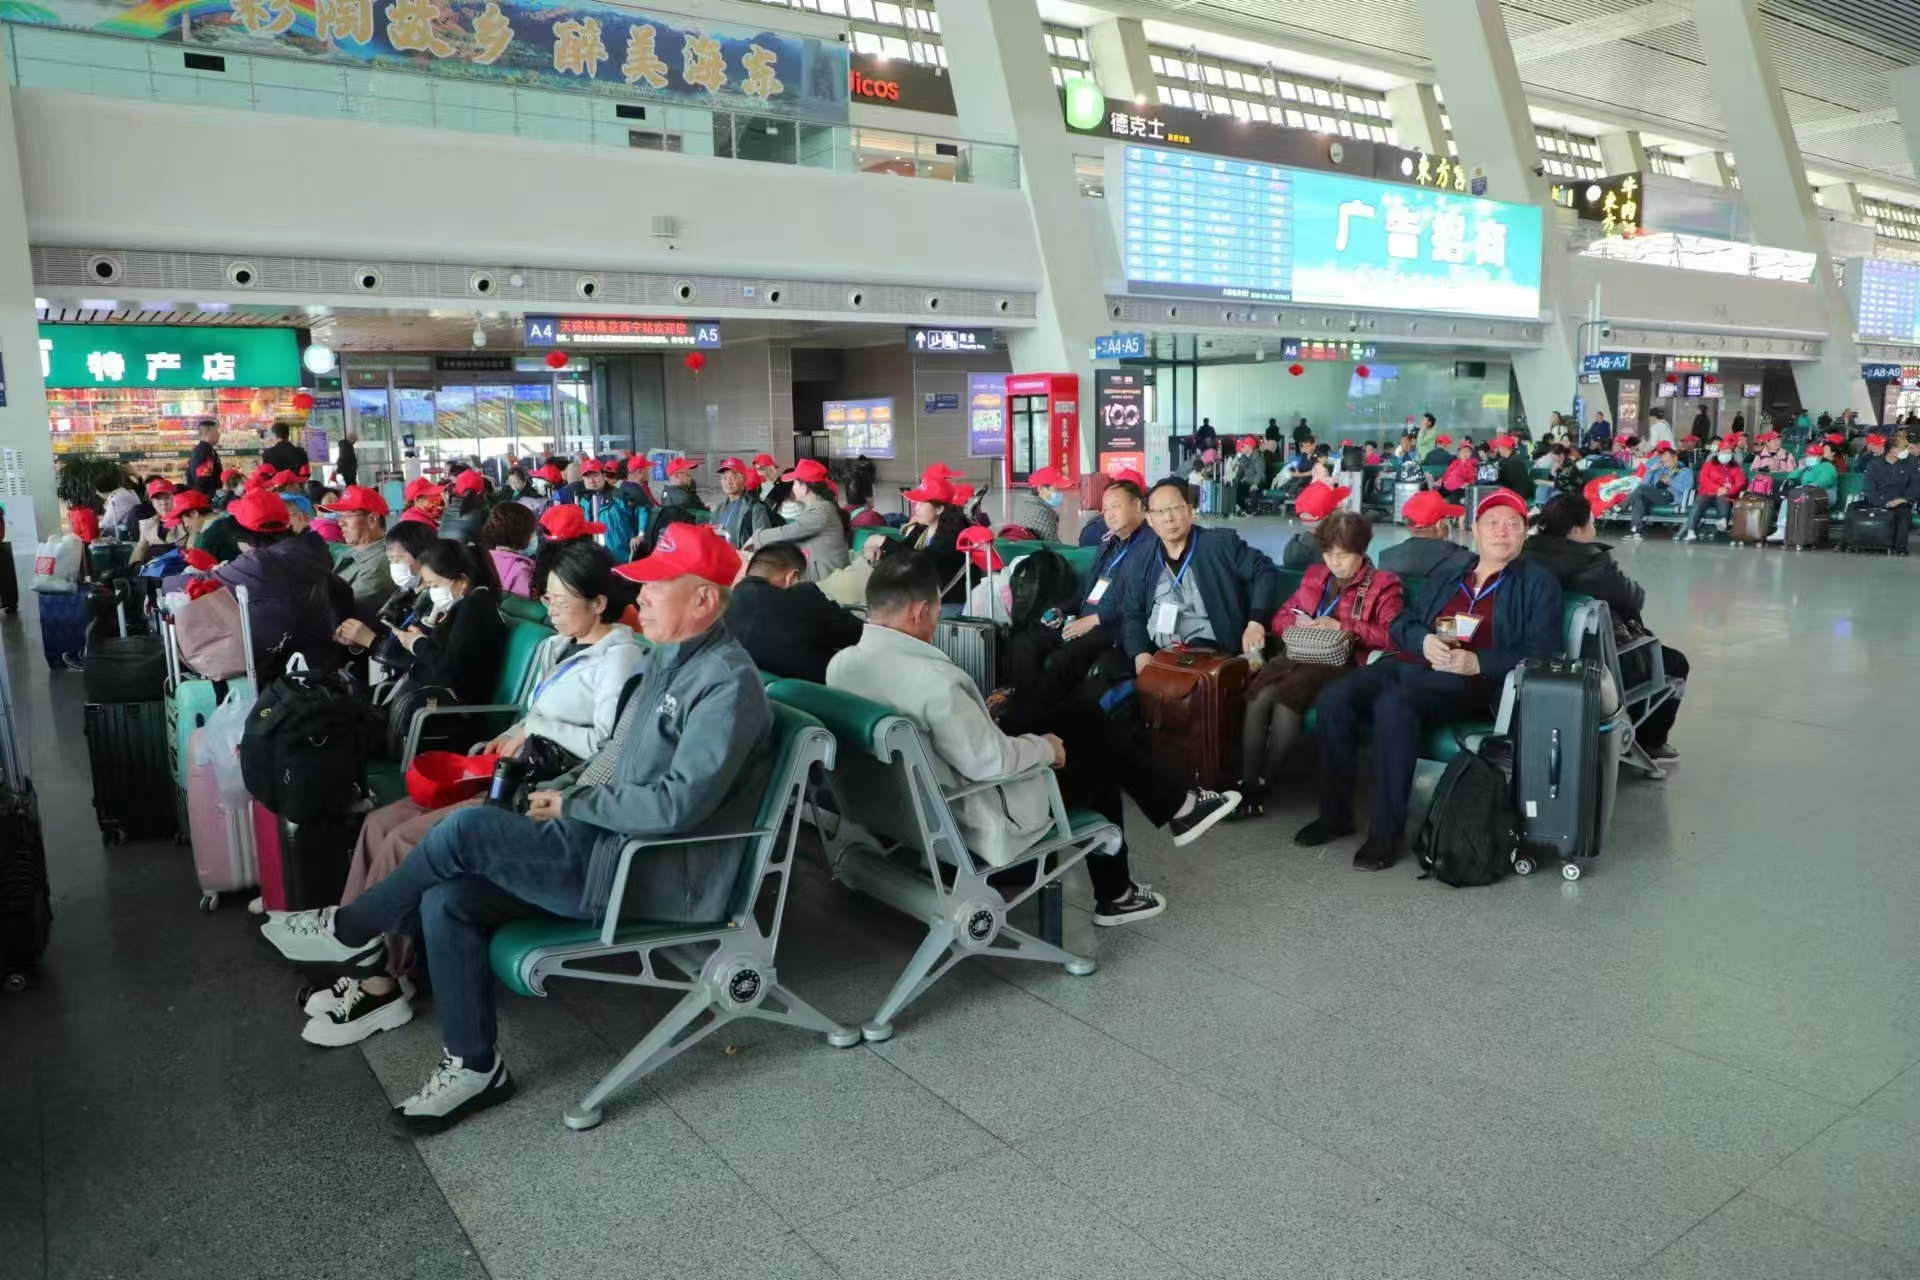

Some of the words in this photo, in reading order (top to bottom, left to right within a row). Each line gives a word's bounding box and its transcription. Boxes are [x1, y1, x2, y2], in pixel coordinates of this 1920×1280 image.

[553, 17, 784, 100] 醉美海东
[1110, 112, 1165, 140] 德克士
[530, 324, 552, 338] A4
[698, 328, 718, 342] A5
[1285, 345, 1297, 356] A6
[1364, 348, 1376, 359] A7
[1596, 355, 1627, 369] A6-A7
[1873, 367, 1901, 378] A8-A9
[1103, 402, 1140, 427] 100
